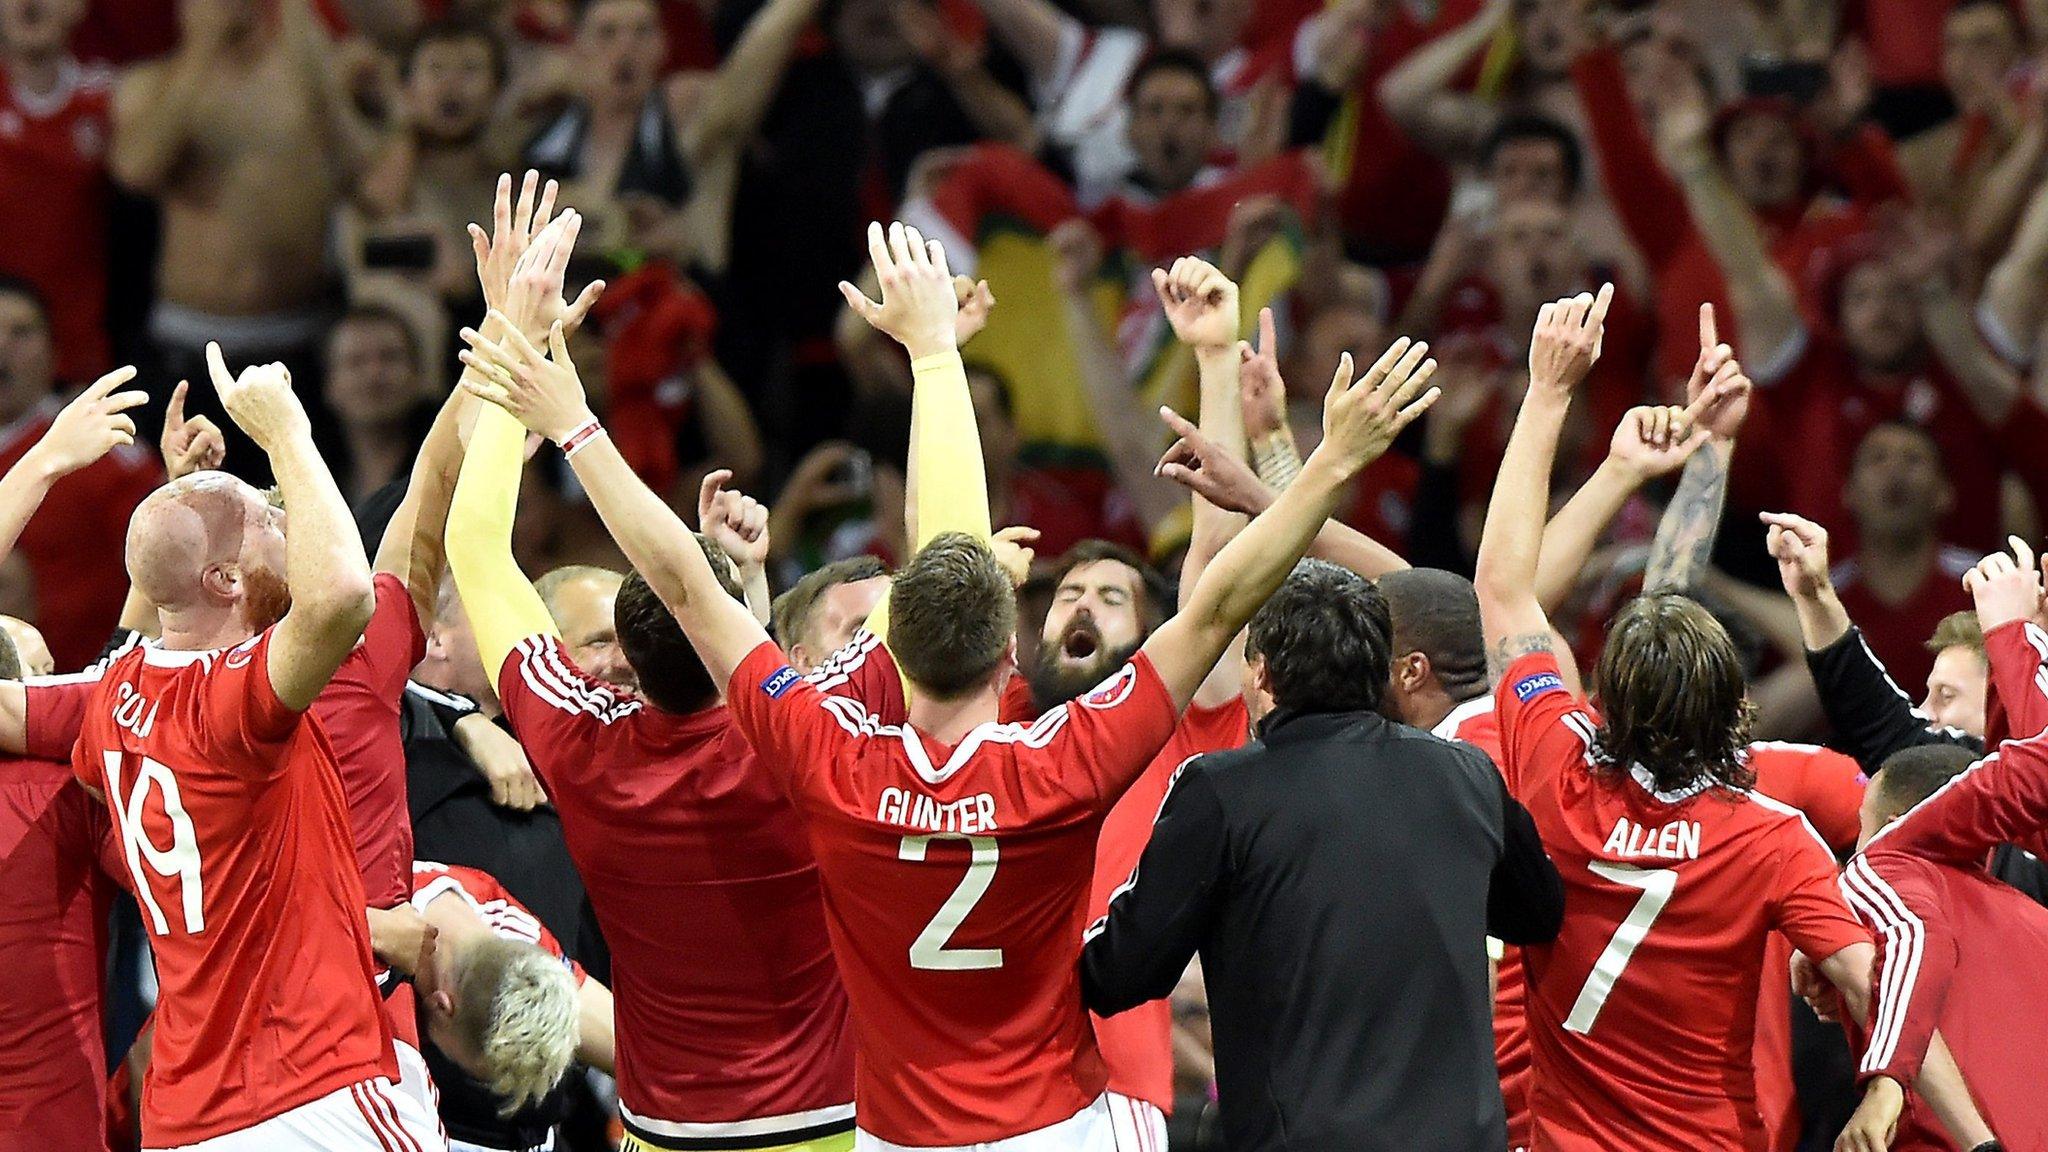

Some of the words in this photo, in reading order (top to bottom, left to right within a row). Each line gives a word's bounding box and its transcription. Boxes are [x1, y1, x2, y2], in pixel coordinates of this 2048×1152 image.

[102, 750, 205, 936] 19
[877, 786, 998, 834] GUNTER
[1602, 817, 1701, 860] ALLEN
[898, 832, 1004, 970] 2
[1563, 860, 1679, 1034] 7
